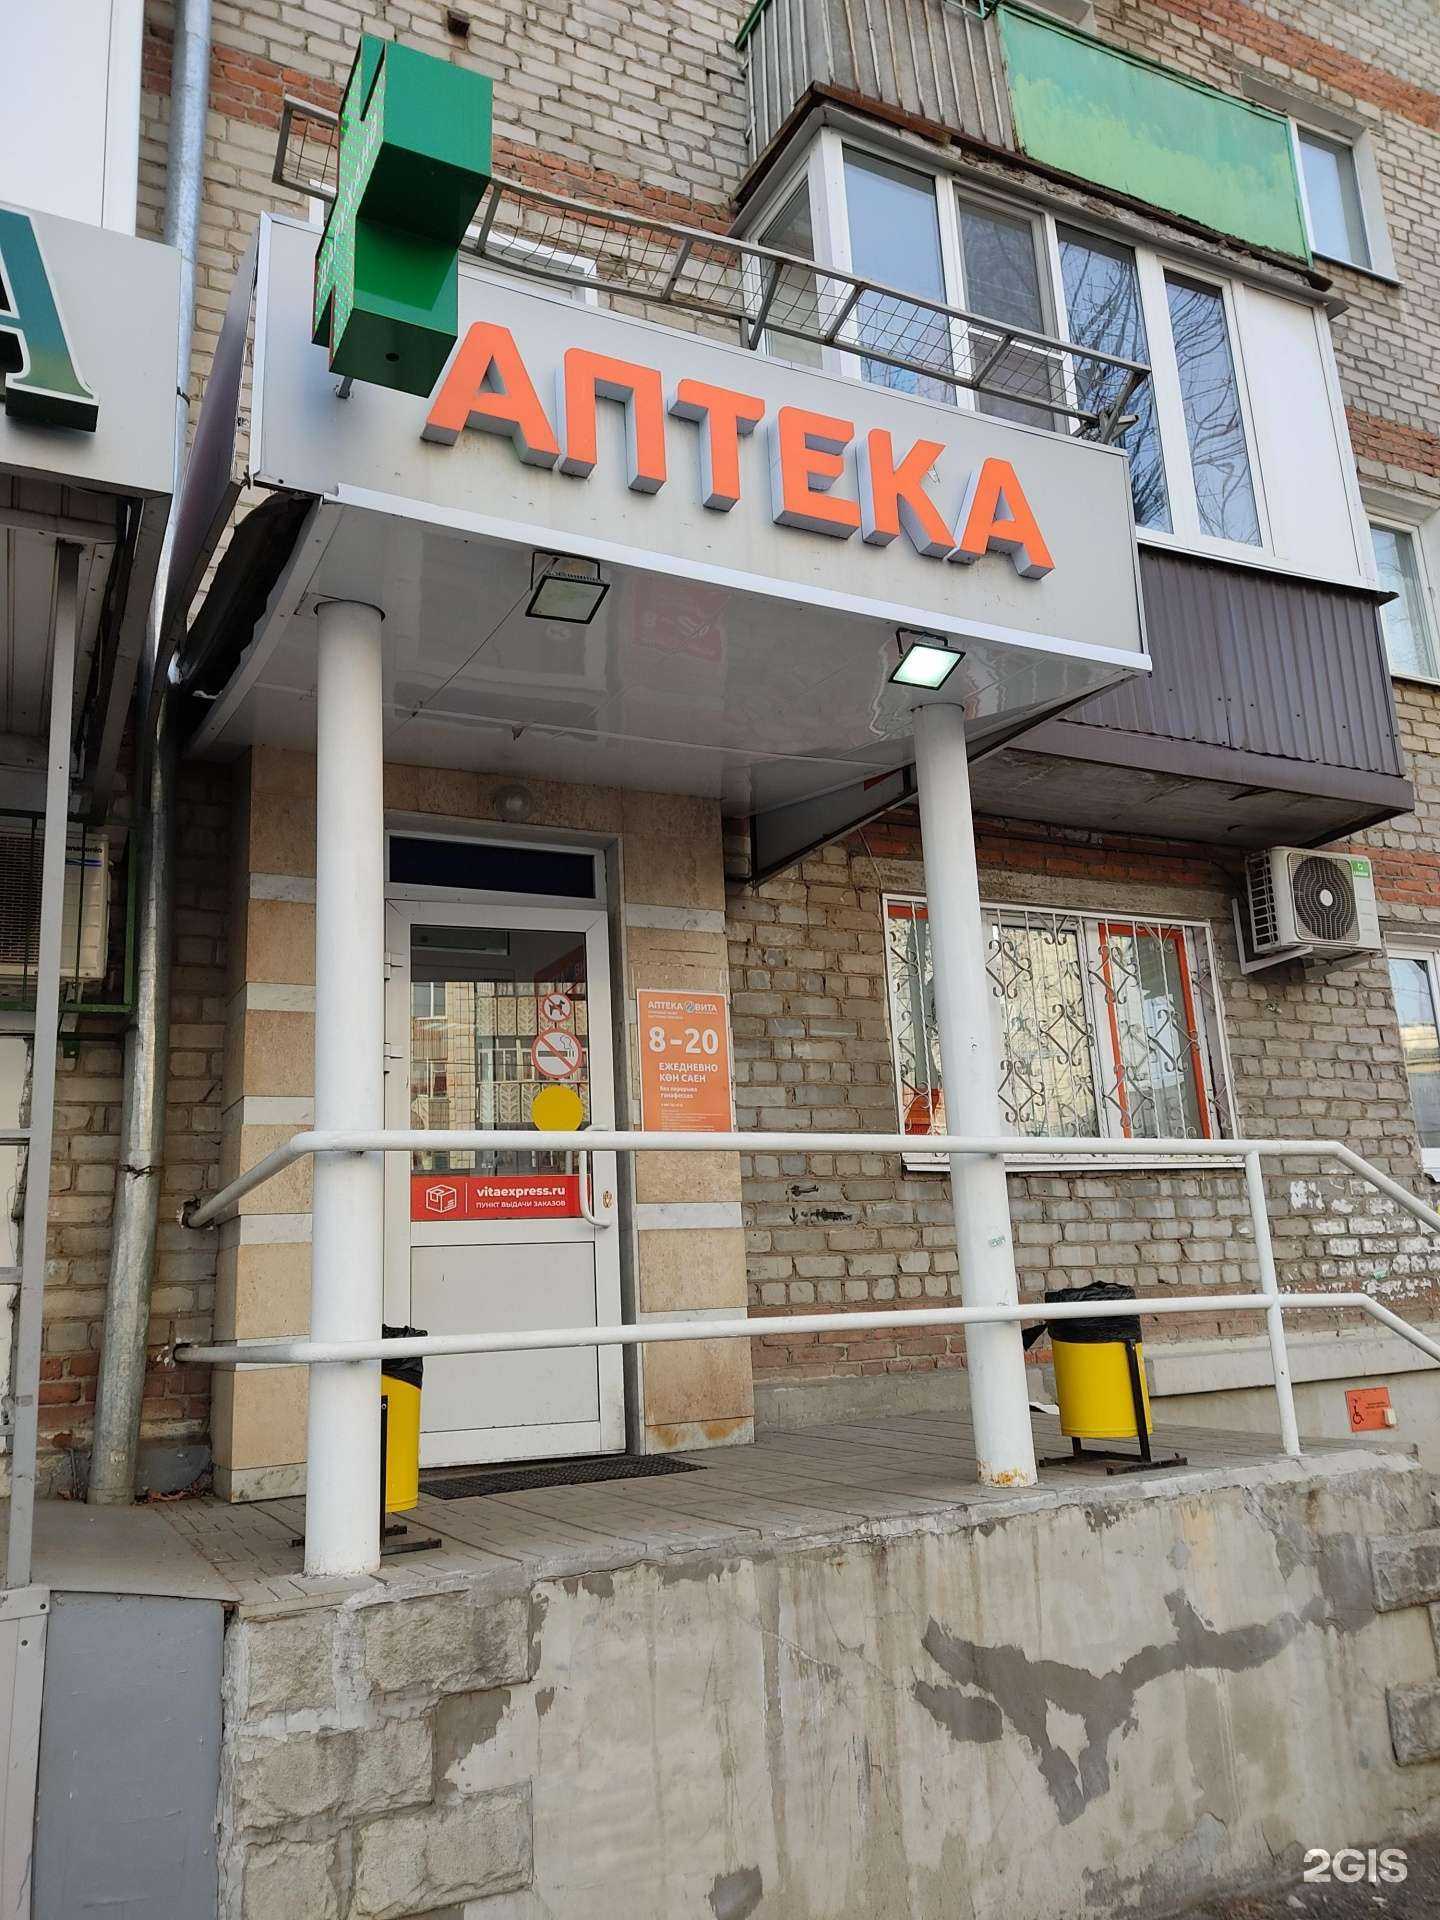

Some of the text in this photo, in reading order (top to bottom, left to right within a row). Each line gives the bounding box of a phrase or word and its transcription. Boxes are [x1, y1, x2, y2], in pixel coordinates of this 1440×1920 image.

[421, 320, 1056, 579] АПТЕКА
[66, 846, 103, 854] anasonic
[648, 1000, 718, 1012] АПТЕКА ВИТА
[658, 1062, 719, 1073] ЕЖЕДНЕВНО
[681, 1073, 706, 1083] САЕН
[476, 1186, 566, 1199] vitaexpress.ru
[475, 1201, 500, 1209] ПУНКТ
